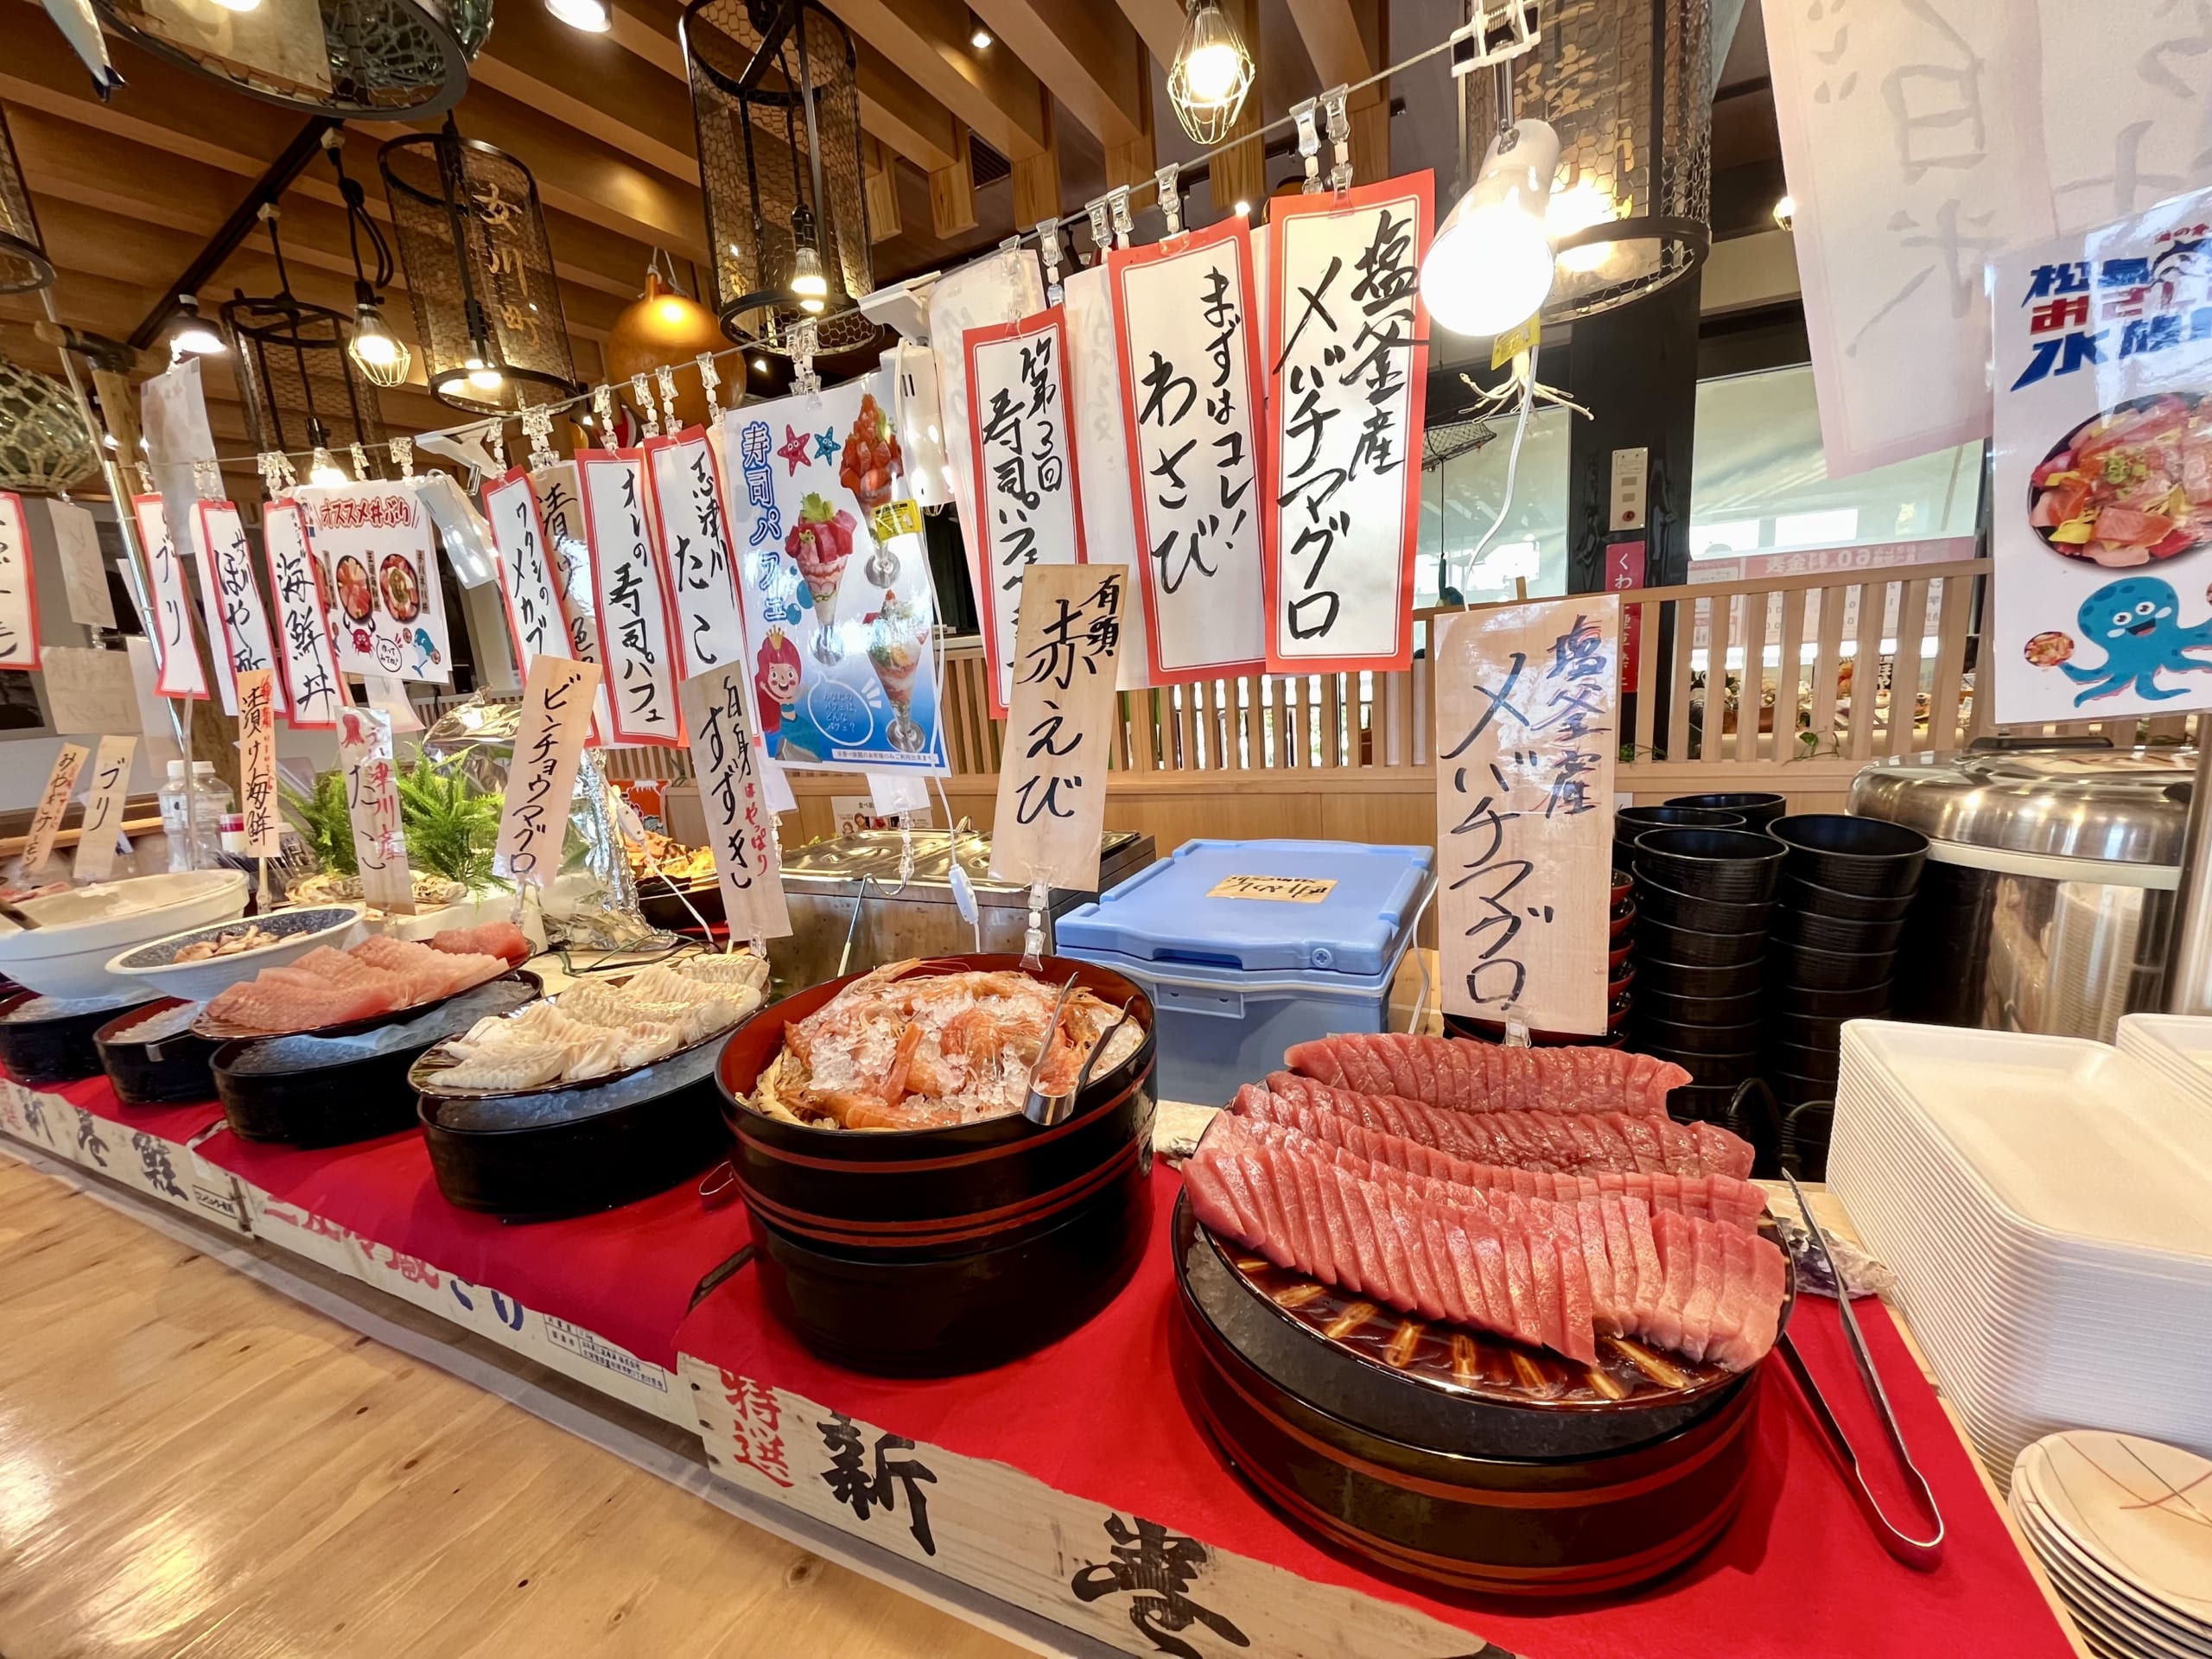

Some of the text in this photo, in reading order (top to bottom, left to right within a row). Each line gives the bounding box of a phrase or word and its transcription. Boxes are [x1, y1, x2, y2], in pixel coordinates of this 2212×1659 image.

[741, 421, 787, 622] 寿司パフェ
[1139, 350, 1219, 595] わさび
[1272, 255, 1350, 640] メバチマグロ
[276, 552, 336, 726] 海鮮丼
[674, 535, 719, 665] たこ
[88, 757, 126, 832] ブリ
[242, 686, 275, 847] 漬け海鮮
[510, 673, 582, 874] ビンチョウマグロ
[1016, 599, 1097, 825] 赤えび
[348, 765, 387, 870] たこ
[1440, 652, 1554, 1011] メバチマグロ
[719, 1369, 796, 1489] 特選
